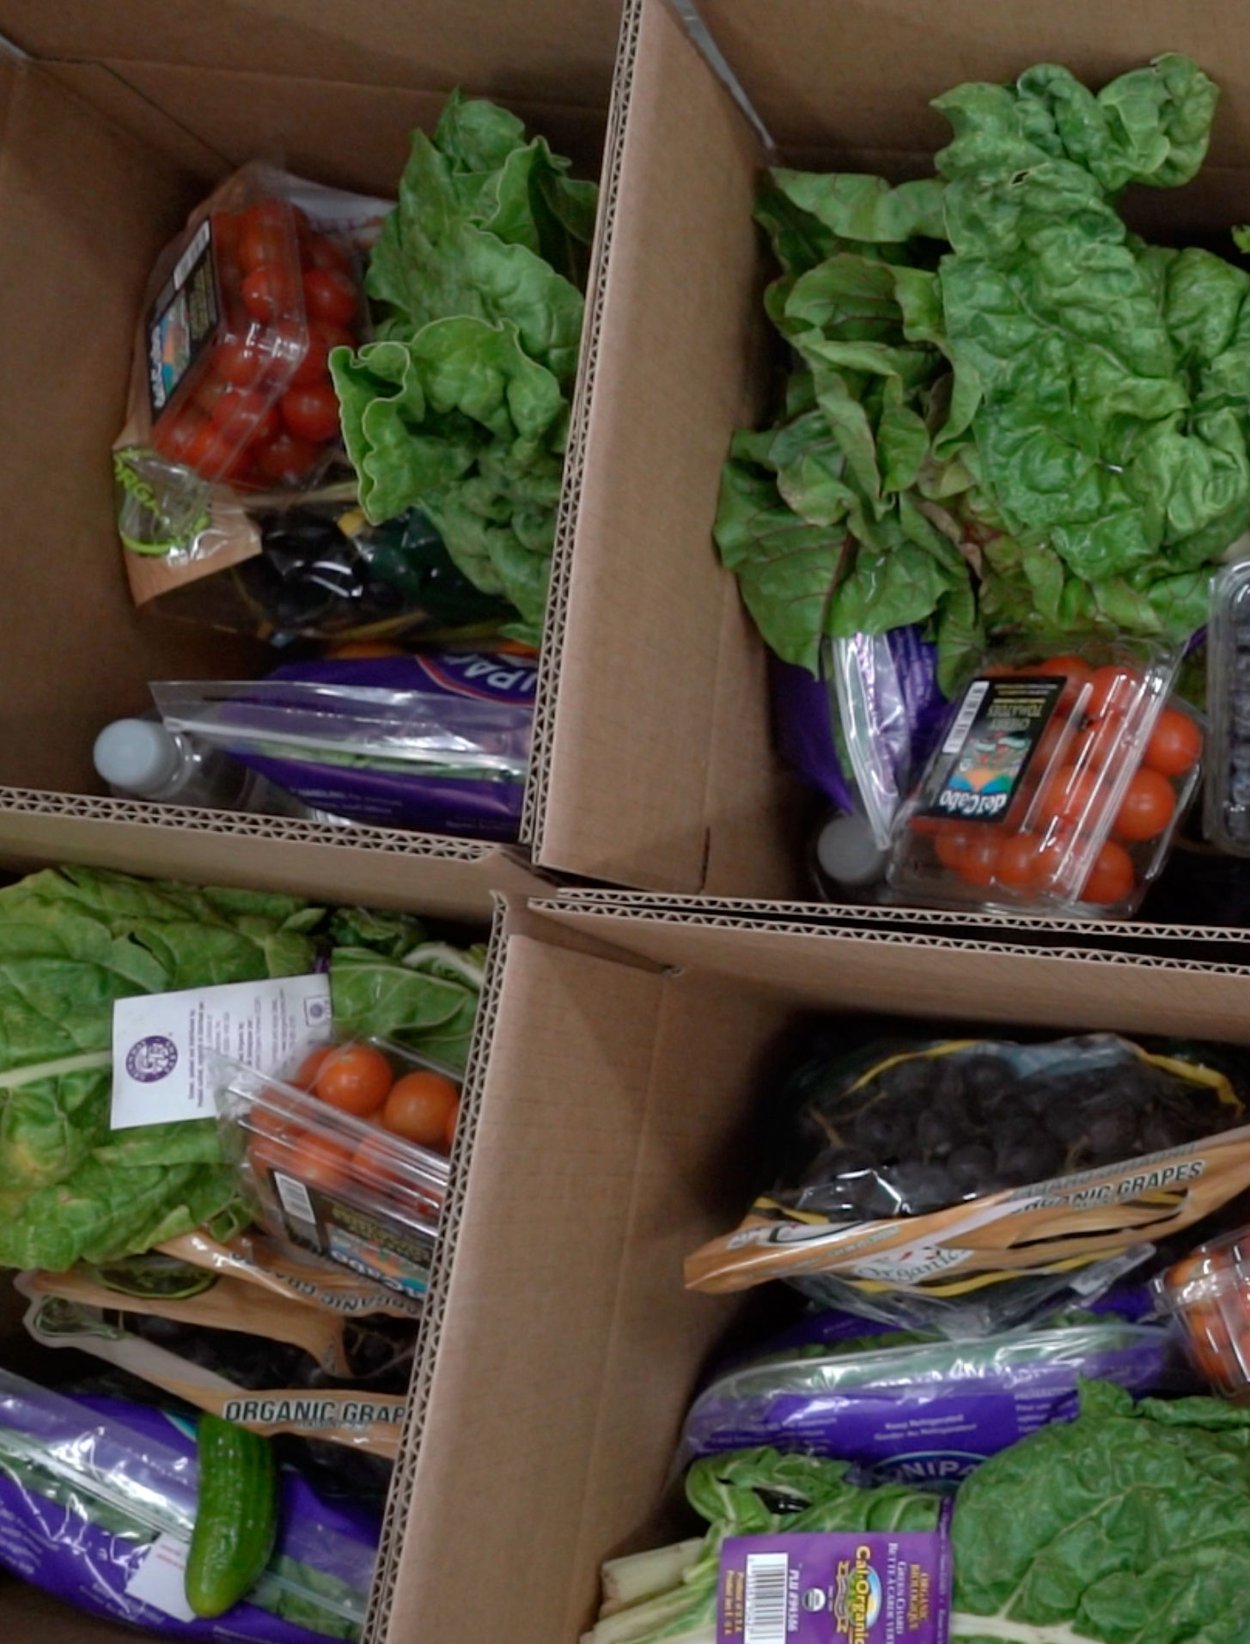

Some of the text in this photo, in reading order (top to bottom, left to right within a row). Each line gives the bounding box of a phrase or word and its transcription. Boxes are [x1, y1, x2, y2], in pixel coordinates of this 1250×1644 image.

[1116, 1161, 1204, 1195] GRAPES
[224, 1400, 336, 1422] ORGANIC
[886, 1542, 899, 1575] BETTE
[896, 1561, 907, 1636] GREEN CHARD
